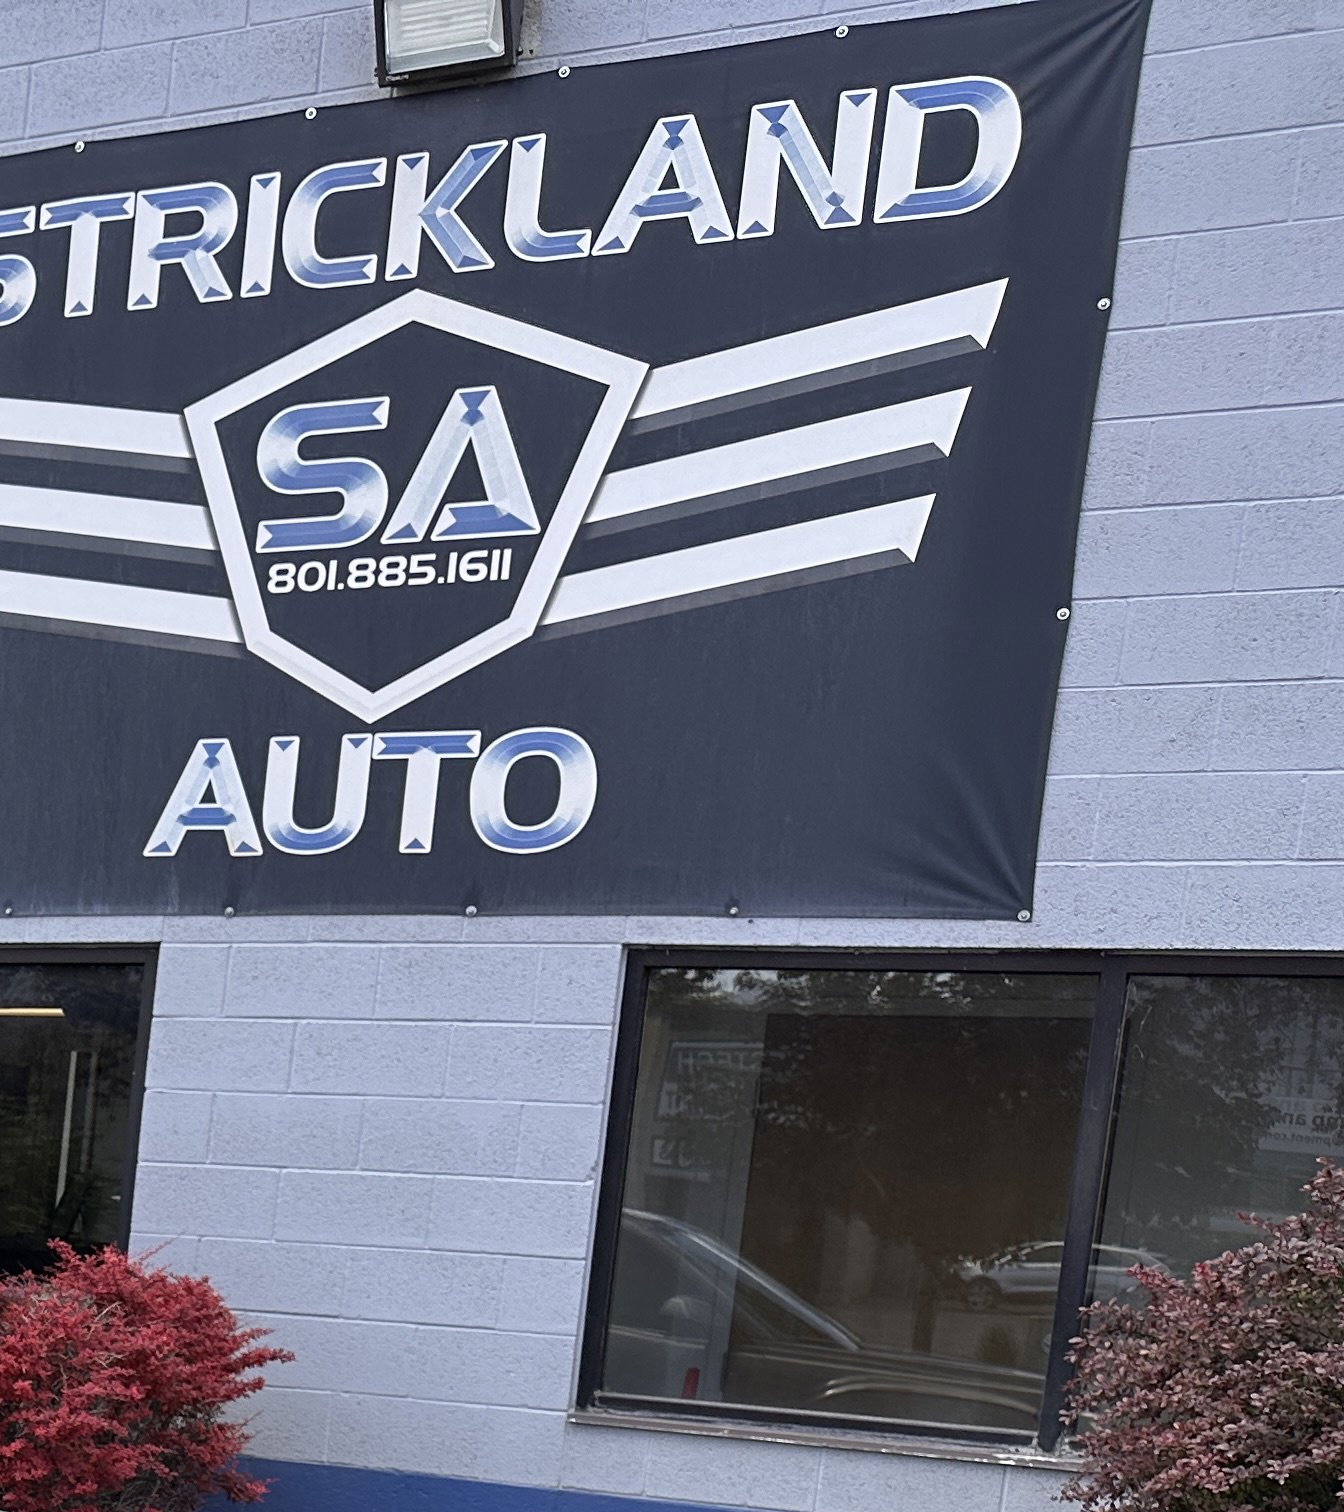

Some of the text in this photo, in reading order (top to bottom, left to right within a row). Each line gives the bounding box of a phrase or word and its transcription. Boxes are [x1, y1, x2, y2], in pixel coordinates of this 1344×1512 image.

[256, 384, 541, 554] SA
[267, 547, 512, 595] 801.885.1611
[143, 726, 598, 857] AUTO
